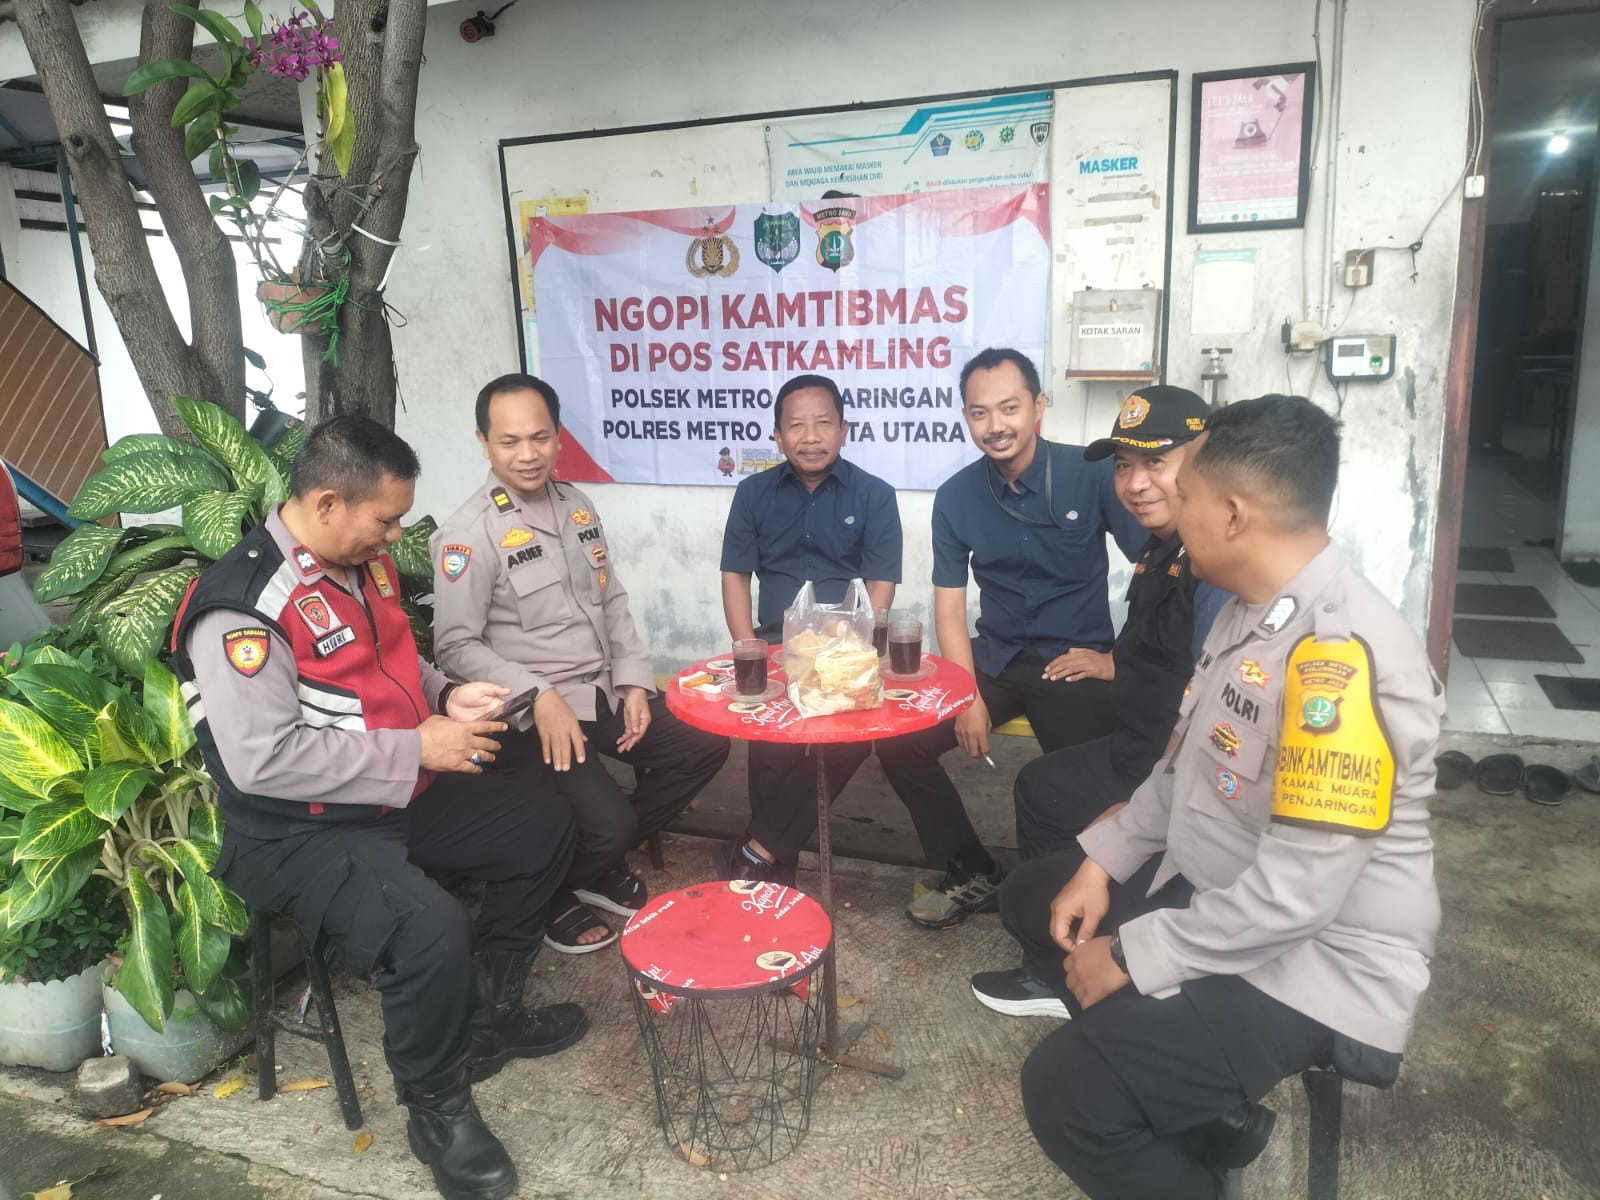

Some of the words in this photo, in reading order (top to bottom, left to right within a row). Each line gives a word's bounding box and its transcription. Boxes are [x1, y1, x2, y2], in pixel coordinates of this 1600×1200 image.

[787, 168, 803, 177] AREA
[804, 166, 823, 175] WAJIB
[824, 163, 854, 173] MEMAKAI
[856, 161, 882, 170] MASKER
[1079, 156, 1138, 174] MASKER
[785, 180, 799, 188] DAN
[800, 177, 829, 187] MENJAGA
[831, 173, 869, 184] KEBERSIHAN
[869, 172, 883, 181] DIRI
[594, 296, 710, 331] NGOPI
[721, 285, 968, 329] KAMTIBMAS
[1081, 327, 1109, 336] KOTAK
[1111, 327, 1141, 336] SARAN
[610, 343, 639, 372] DI
[649, 341, 713, 372] POS
[722, 336, 952, 371] SATKAMLING
[611, 389, 691, 408] POLSEK
[698, 388, 773, 409] METRO
[842, 387, 953, 409] ARINGAN
[603, 420, 681, 440] POLRES
[687, 420, 762, 441] METRO
[883, 421, 966, 443] UTARA
[508, 545, 544, 569] ARIEF
[1221, 682, 1259, 724] POLRI
[1277, 745, 1382, 787] BINKAMTIBMAS
[1282, 777, 1323, 792] KAMAL
[1331, 784, 1378, 800] MUARA
[1282, 793, 1377, 817] PENJARINGAN
